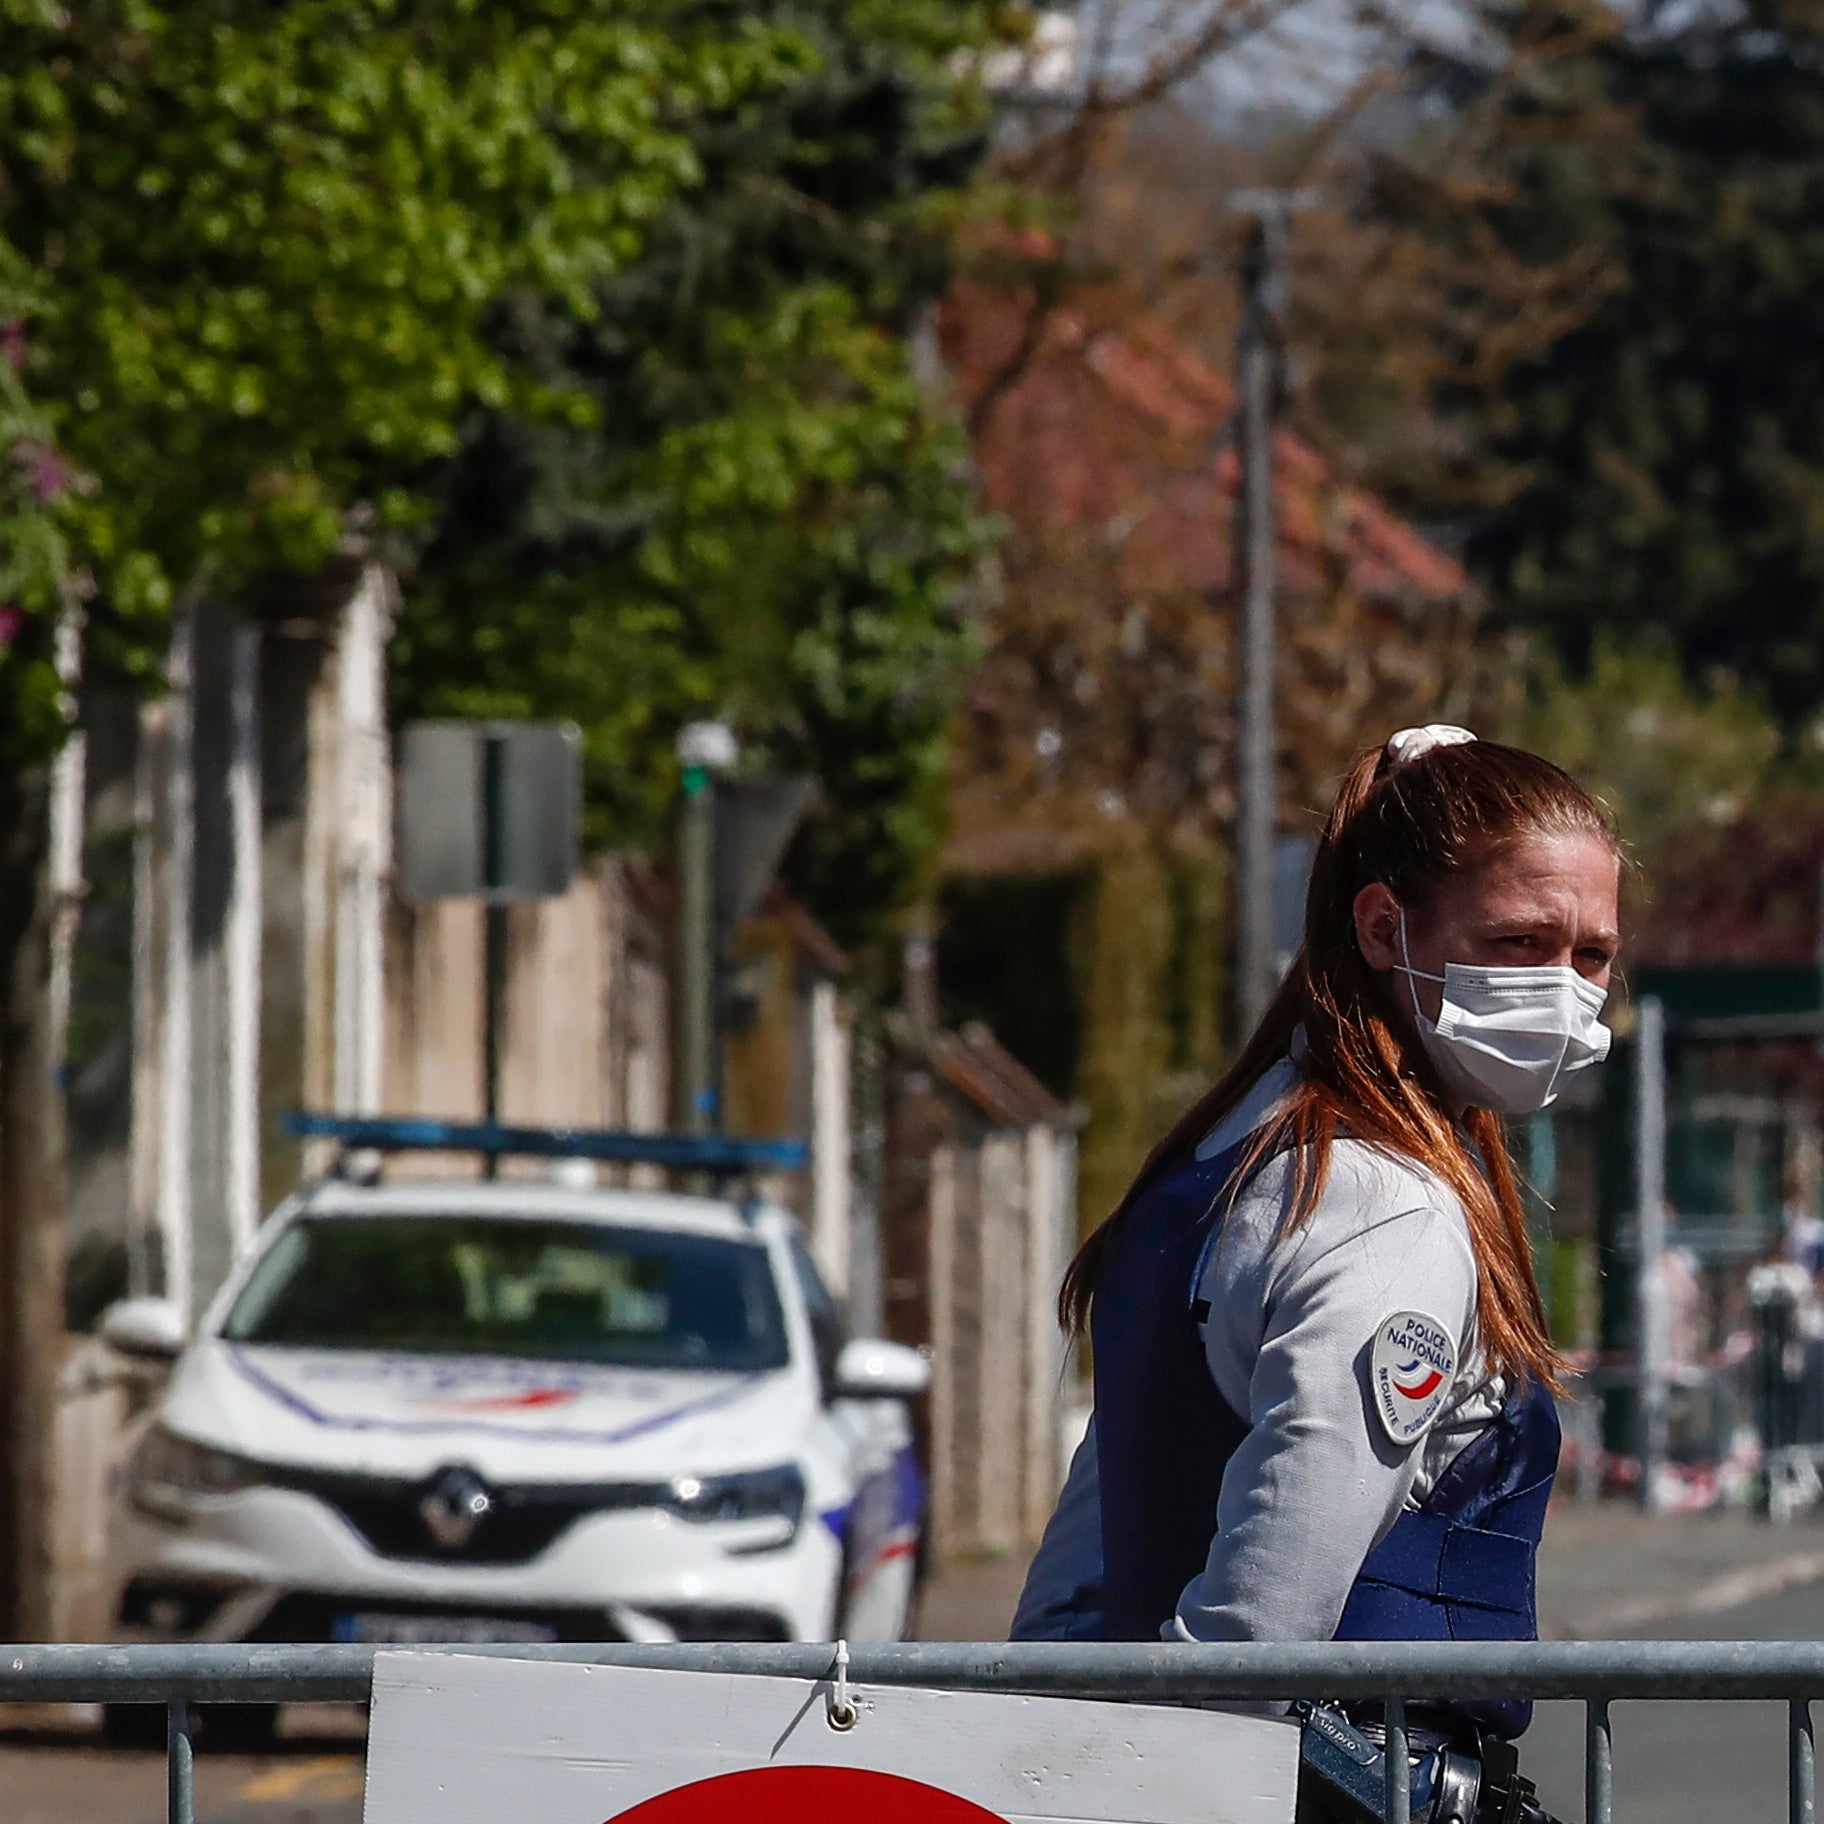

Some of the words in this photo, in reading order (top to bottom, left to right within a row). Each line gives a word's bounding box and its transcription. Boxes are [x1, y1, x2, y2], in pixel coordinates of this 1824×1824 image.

[1387, 1326, 1453, 1373] NATIONALE
[1406, 1318, 1447, 1350] POLICE
[1403, 1394, 1441, 1435] PUBLIQUE
[1333, 1731, 1356, 1750] pro
